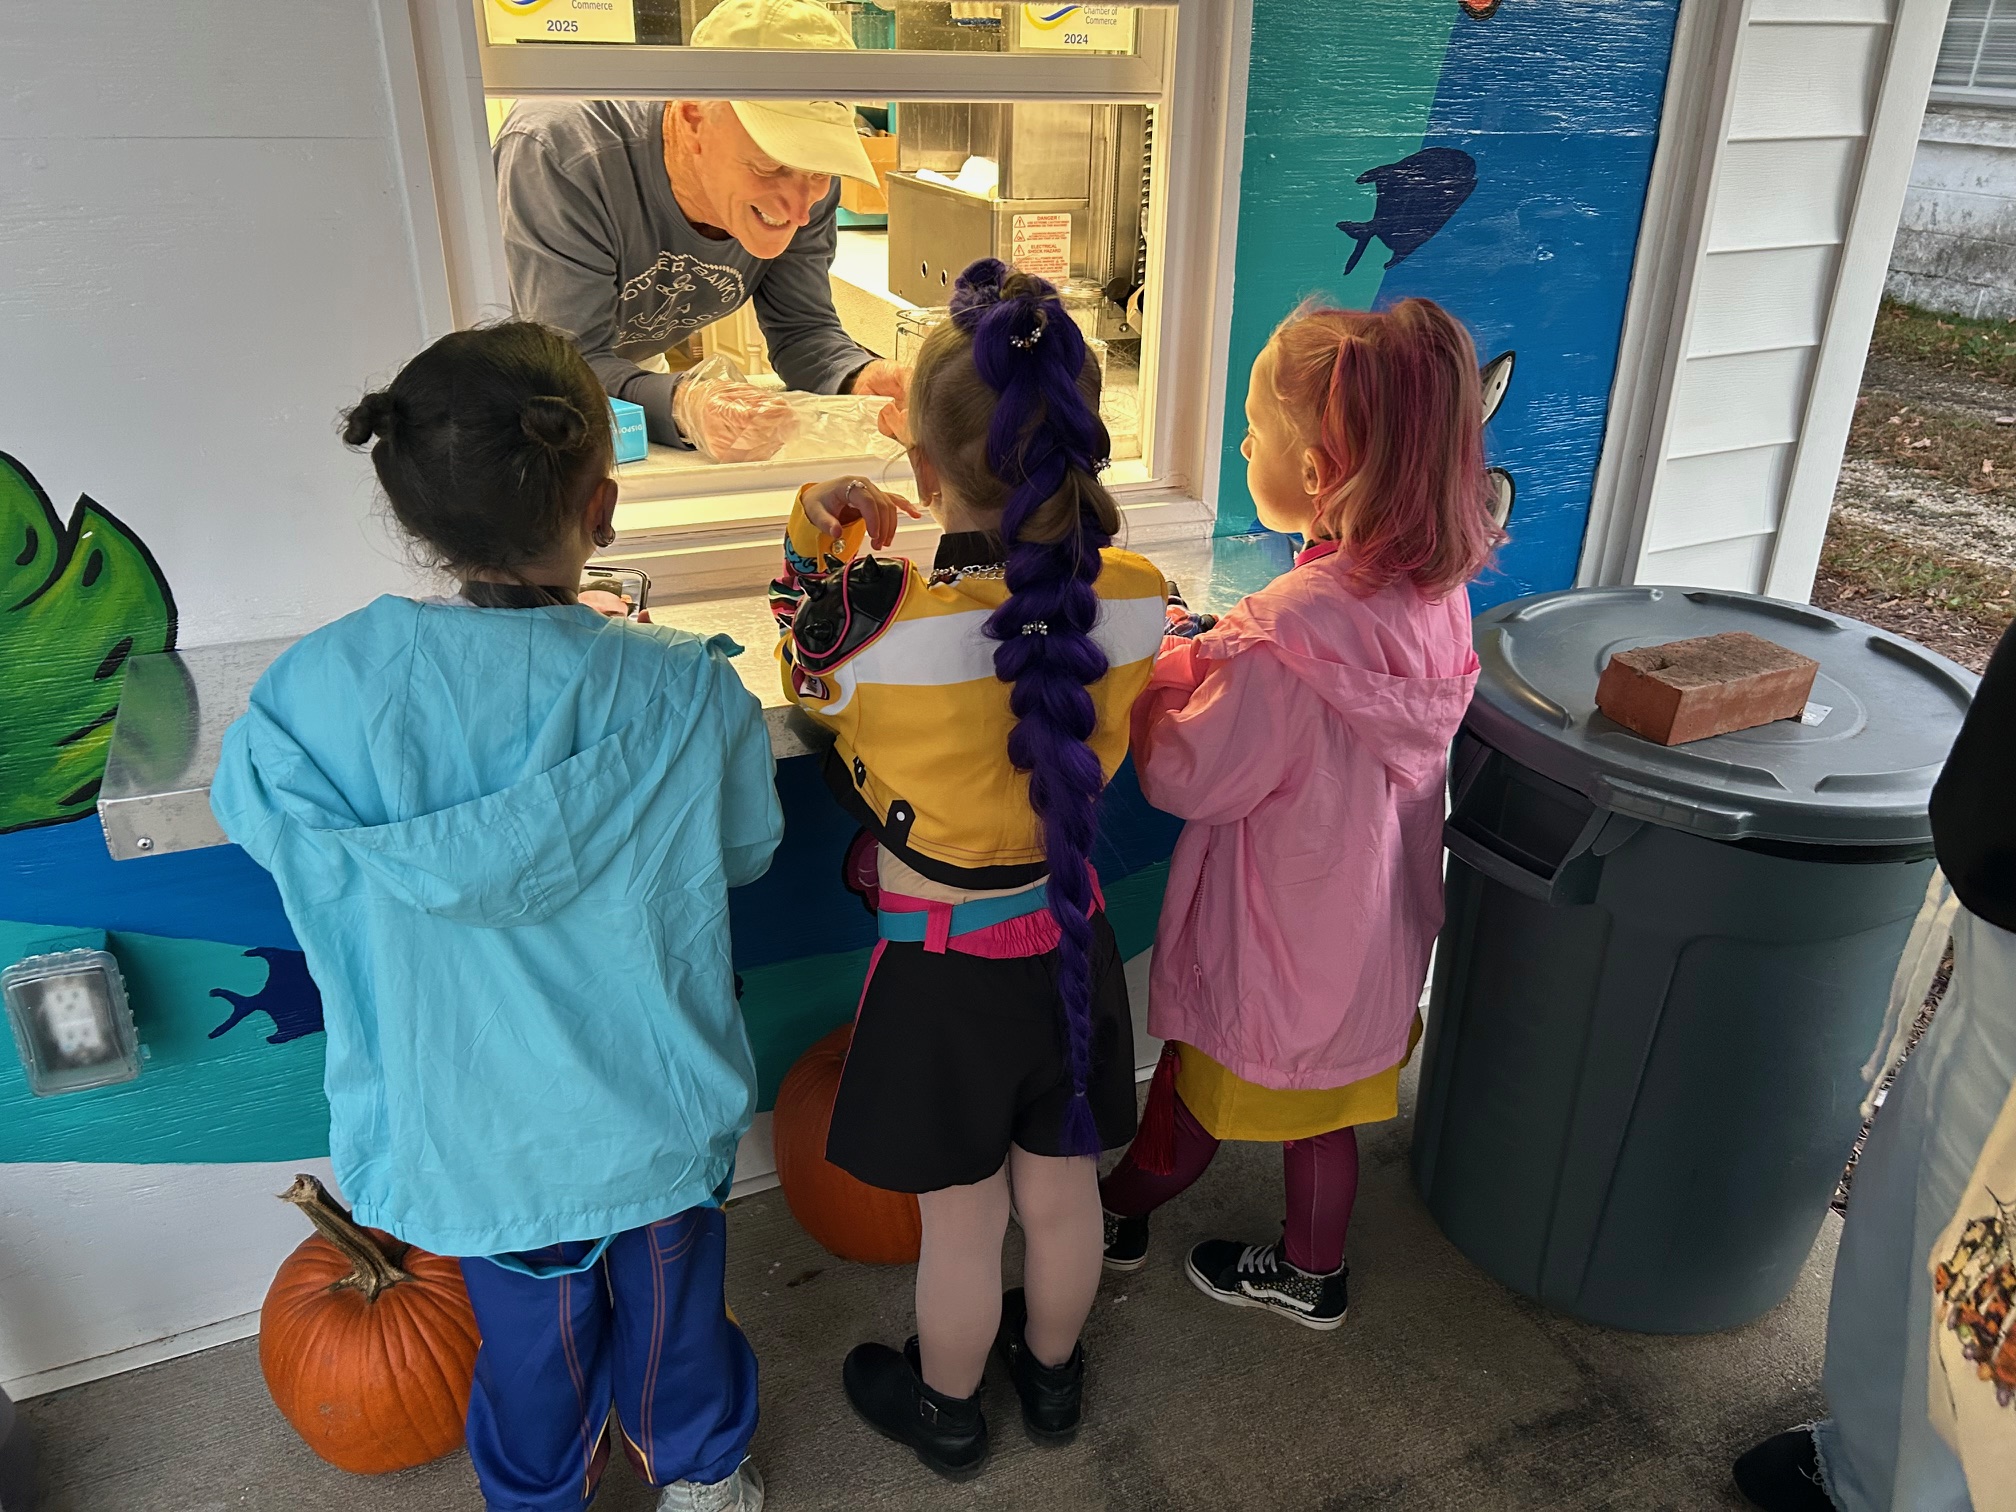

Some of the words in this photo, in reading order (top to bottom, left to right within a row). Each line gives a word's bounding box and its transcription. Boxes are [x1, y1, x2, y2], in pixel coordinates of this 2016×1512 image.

[572, 0, 613, 10] Commerce
[1084, 6, 1110, 15] Chamber
[1112, 7, 1118, 15] of
[1086, 16, 1117, 25] Commerce
[546, 19, 579, 33] 2025
[1064, 34, 1088, 44] 2024
[691, 265, 736, 303] BANKS
